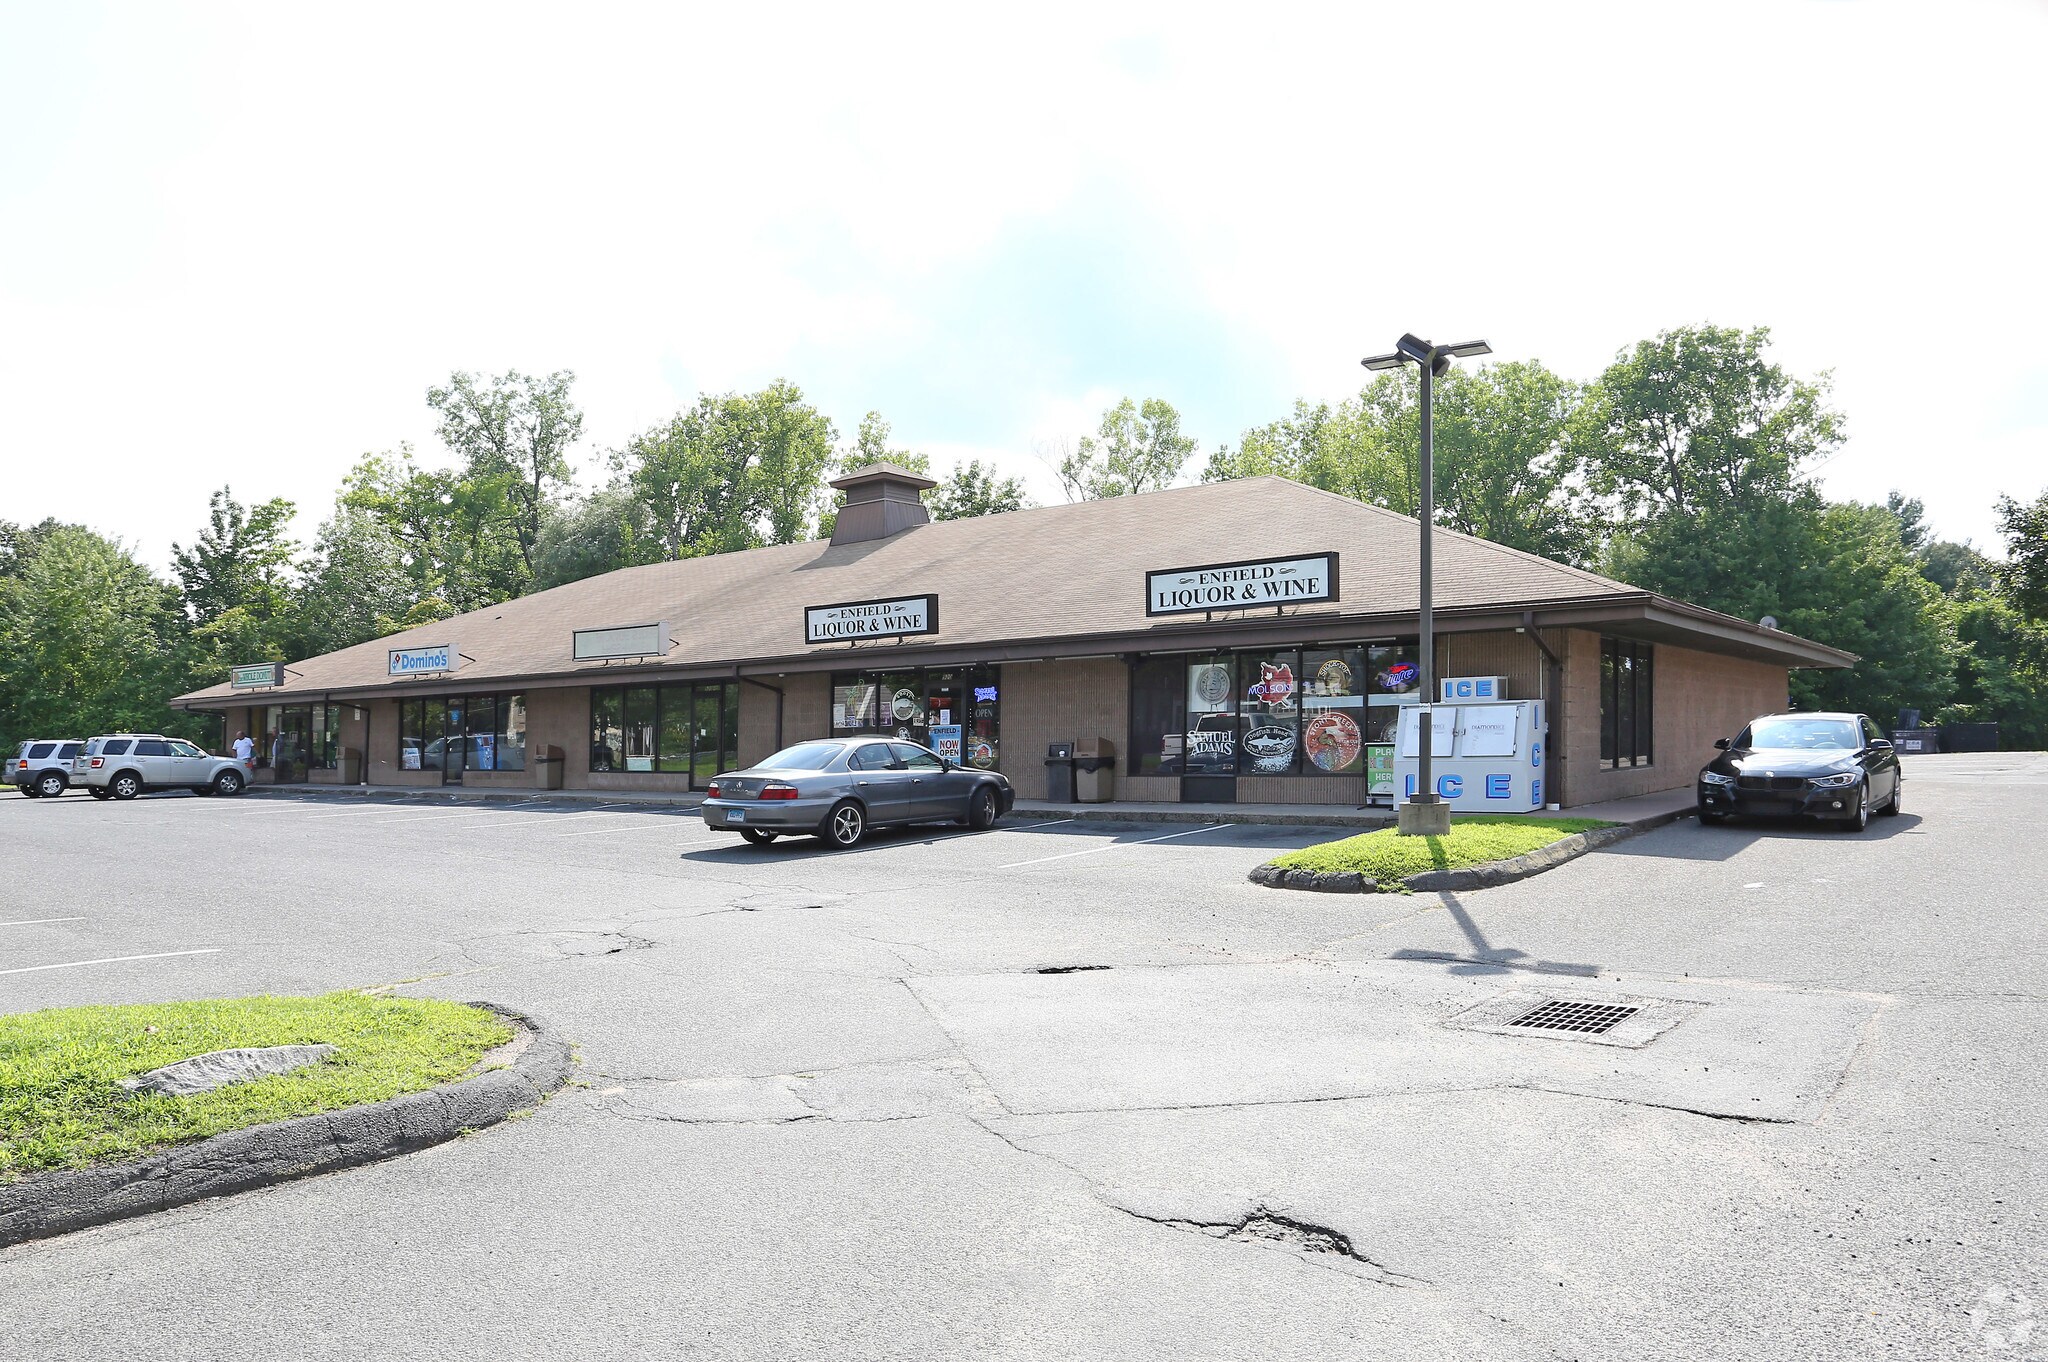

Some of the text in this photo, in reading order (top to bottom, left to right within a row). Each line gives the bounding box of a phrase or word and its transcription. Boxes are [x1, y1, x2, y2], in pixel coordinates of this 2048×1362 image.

[1199, 566, 1275, 585] ENFIELD
[1159, 577, 1320, 608] LIQUOR & WINE
[840, 604, 892, 619] ENFIELD
[814, 614, 922, 637] LIQUOR & WINE
[401, 650, 447, 670] Domino's
[1248, 683, 1292, 695] MOLSON
[1445, 680, 1493, 698] ICE
[975, 708, 993, 718] OPEN
[1273, 729, 1289, 737] Head
[1310, 717, 1329, 736] STONY
[939, 740, 959, 749] NOW
[1187, 731, 1236, 745] SAMUEL
[1190, 743, 1233, 756] ADAMS
[1375, 773, 1392, 781] HER
